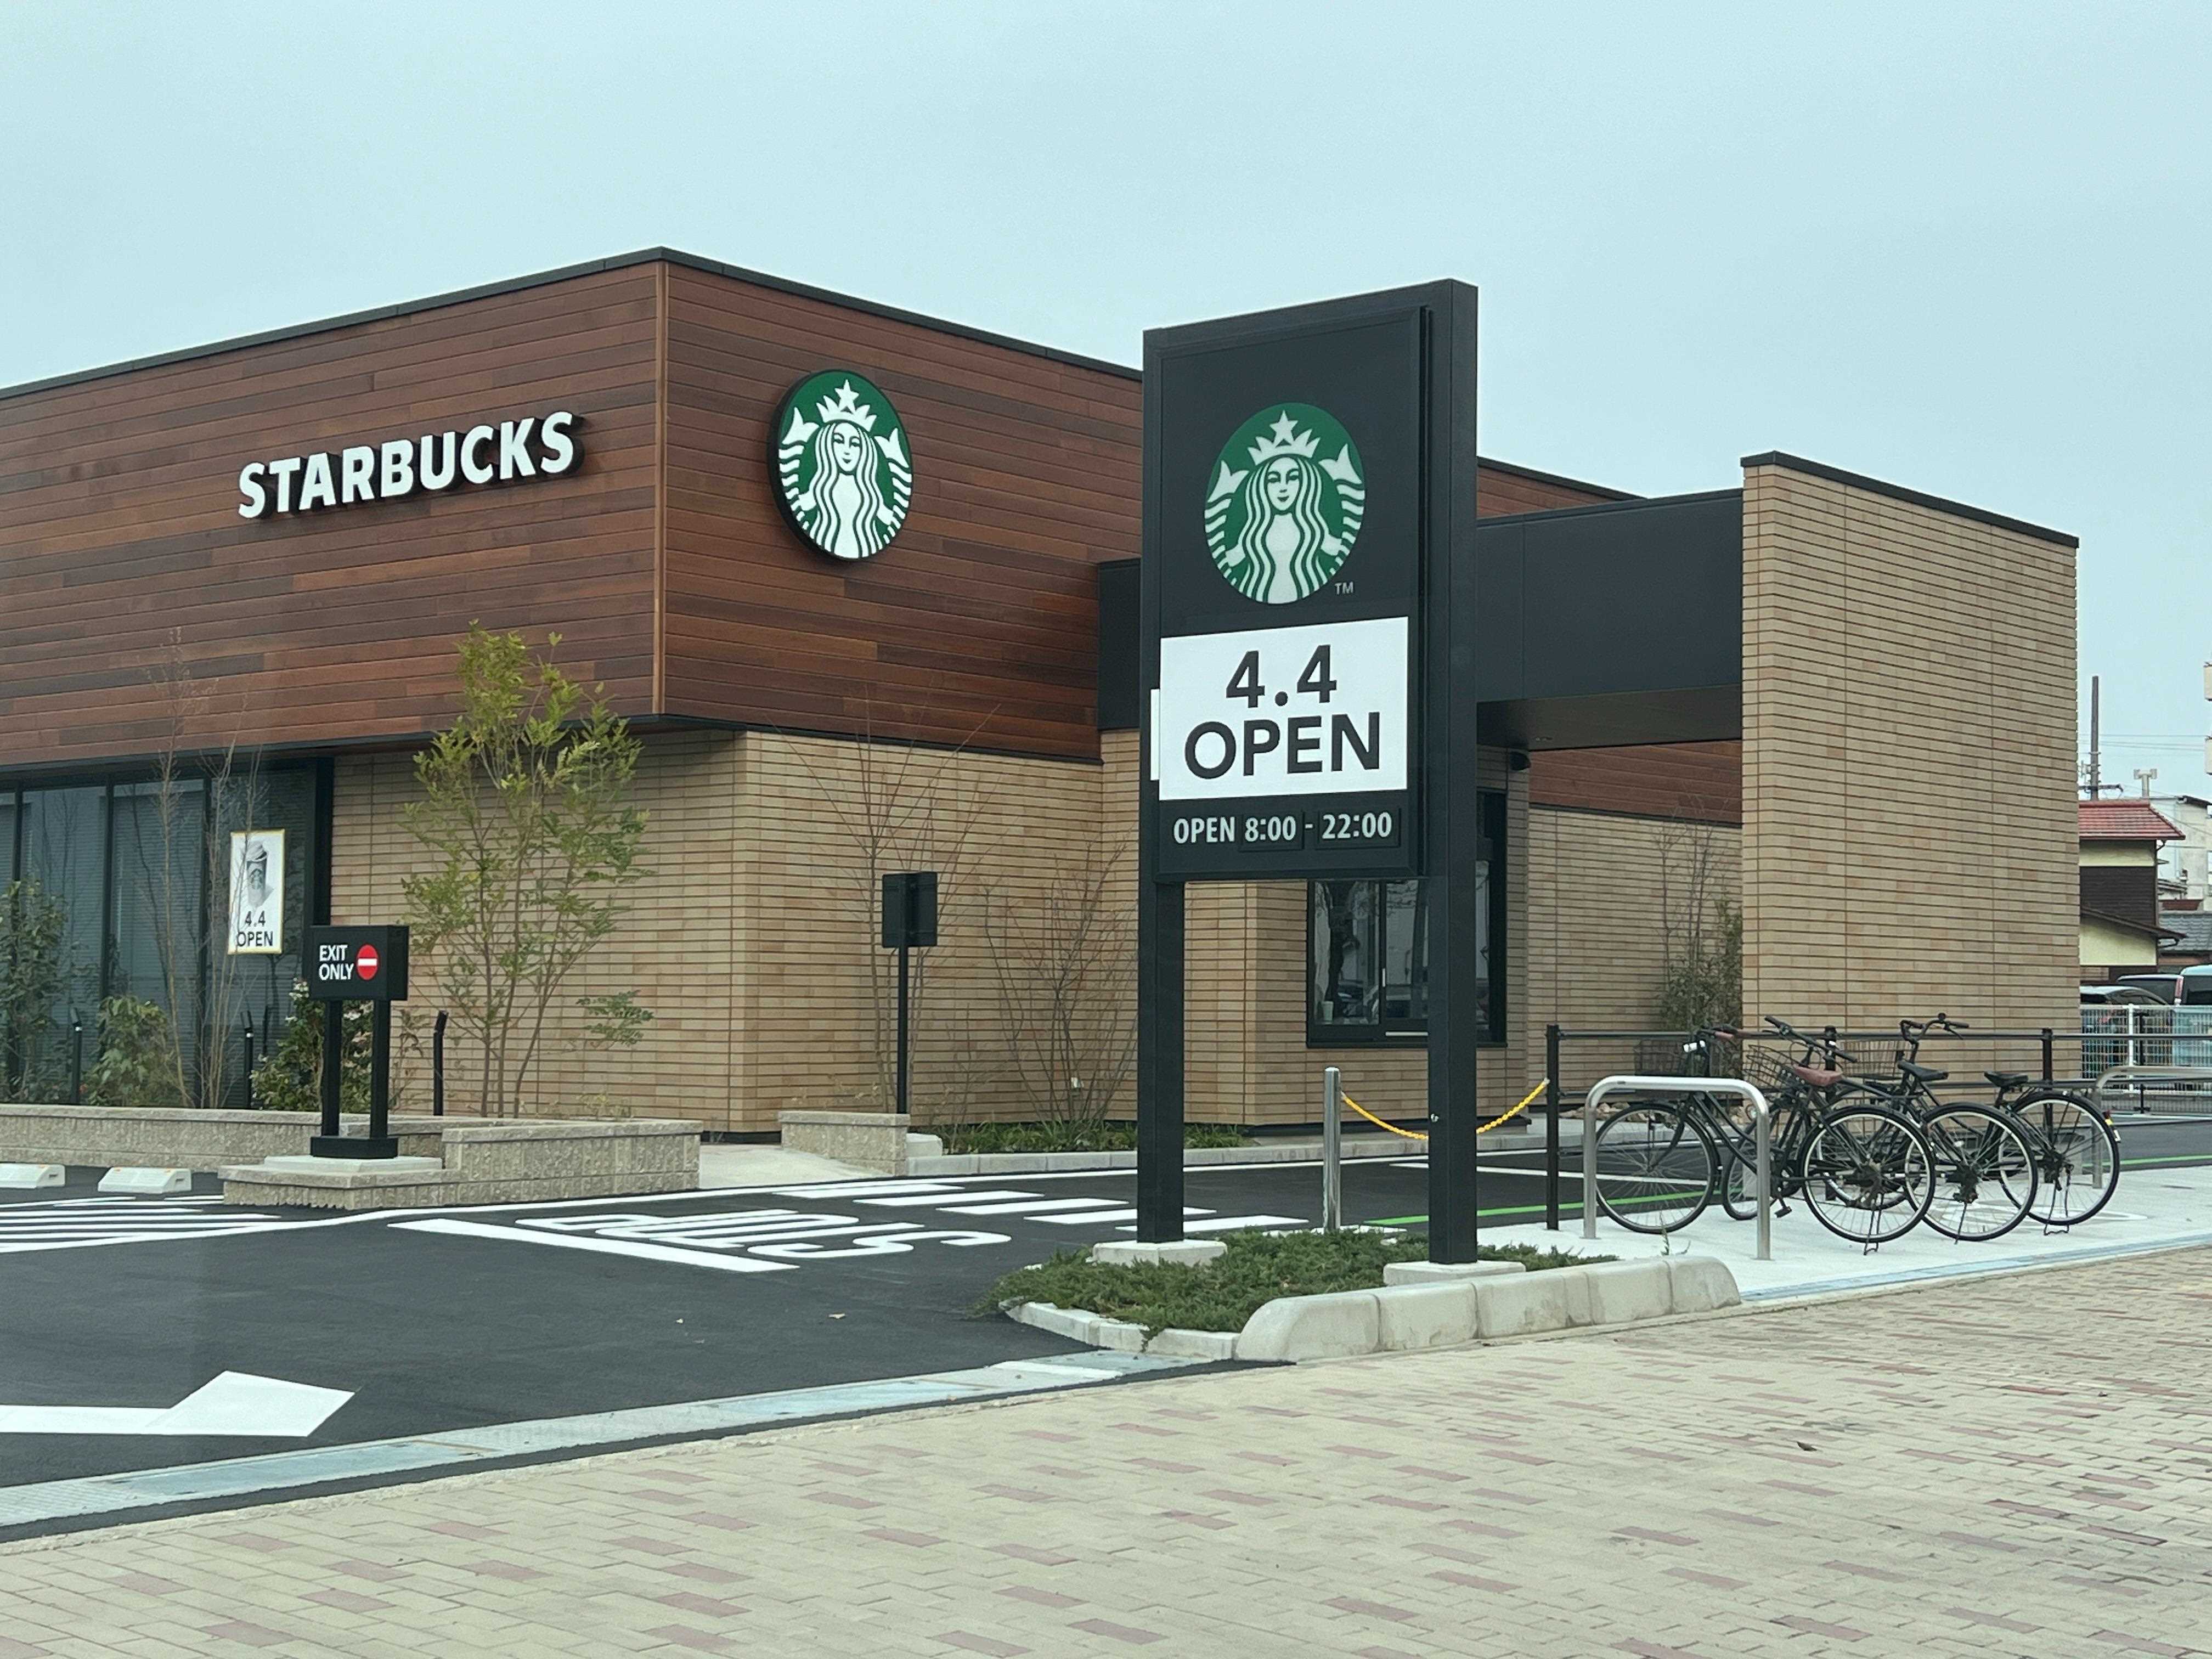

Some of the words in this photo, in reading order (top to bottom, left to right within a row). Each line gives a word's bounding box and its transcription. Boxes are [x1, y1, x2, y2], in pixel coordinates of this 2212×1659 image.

[238, 411, 575, 518] STARBUCKS
[1335, 582, 1354, 595] TM
[1226, 644, 1338, 709] 4.4
[1184, 712, 1380, 780] OPEN
[1173, 816, 1235, 844] OPEN
[1244, 815, 1296, 842] 8:00
[1322, 811, 1392, 840] 22:00
[244, 910, 266, 927] 4.4
[236, 931, 274, 947] OPEN
[319, 944, 348, 961] EXIT
[318, 963, 354, 981] ONLY
[515, 1209, 1012, 1259] STOP
